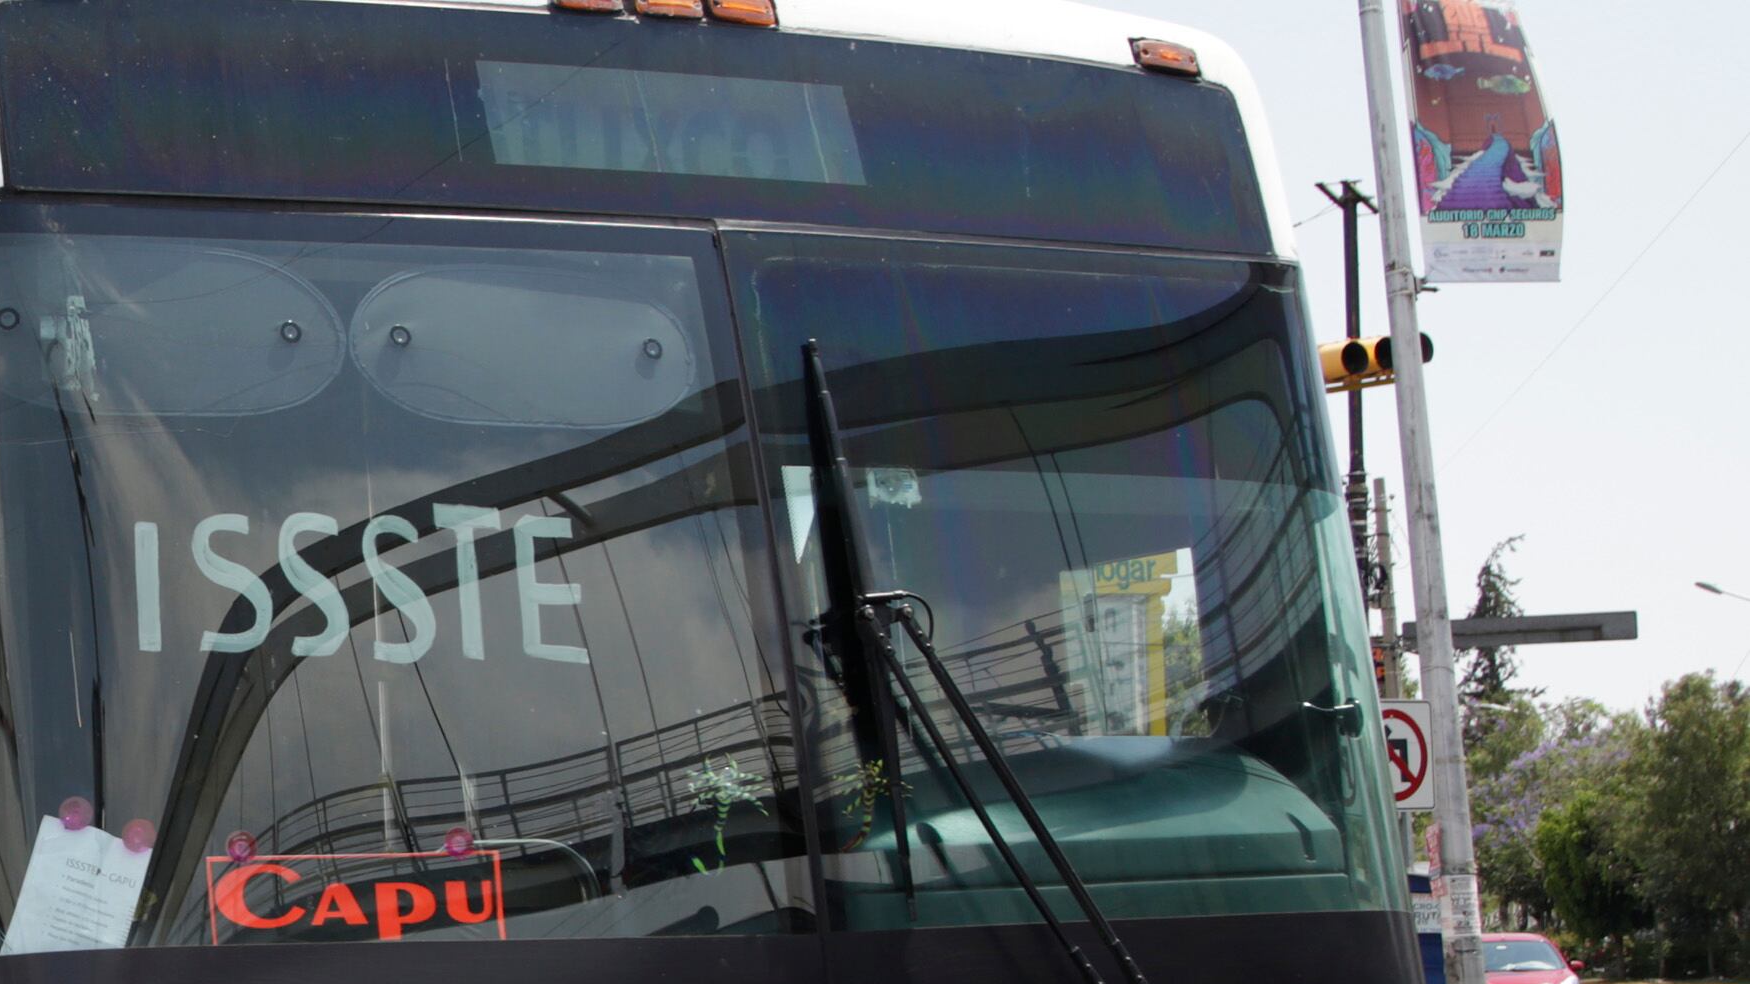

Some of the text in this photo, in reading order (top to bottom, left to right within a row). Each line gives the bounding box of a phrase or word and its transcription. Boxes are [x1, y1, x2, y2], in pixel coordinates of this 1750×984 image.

[1428, 208, 1556, 222] AUDITORIO GNP SEGUROS
[1481, 223, 1525, 238] MARZO
[135, 504, 589, 664] ISSSTE
